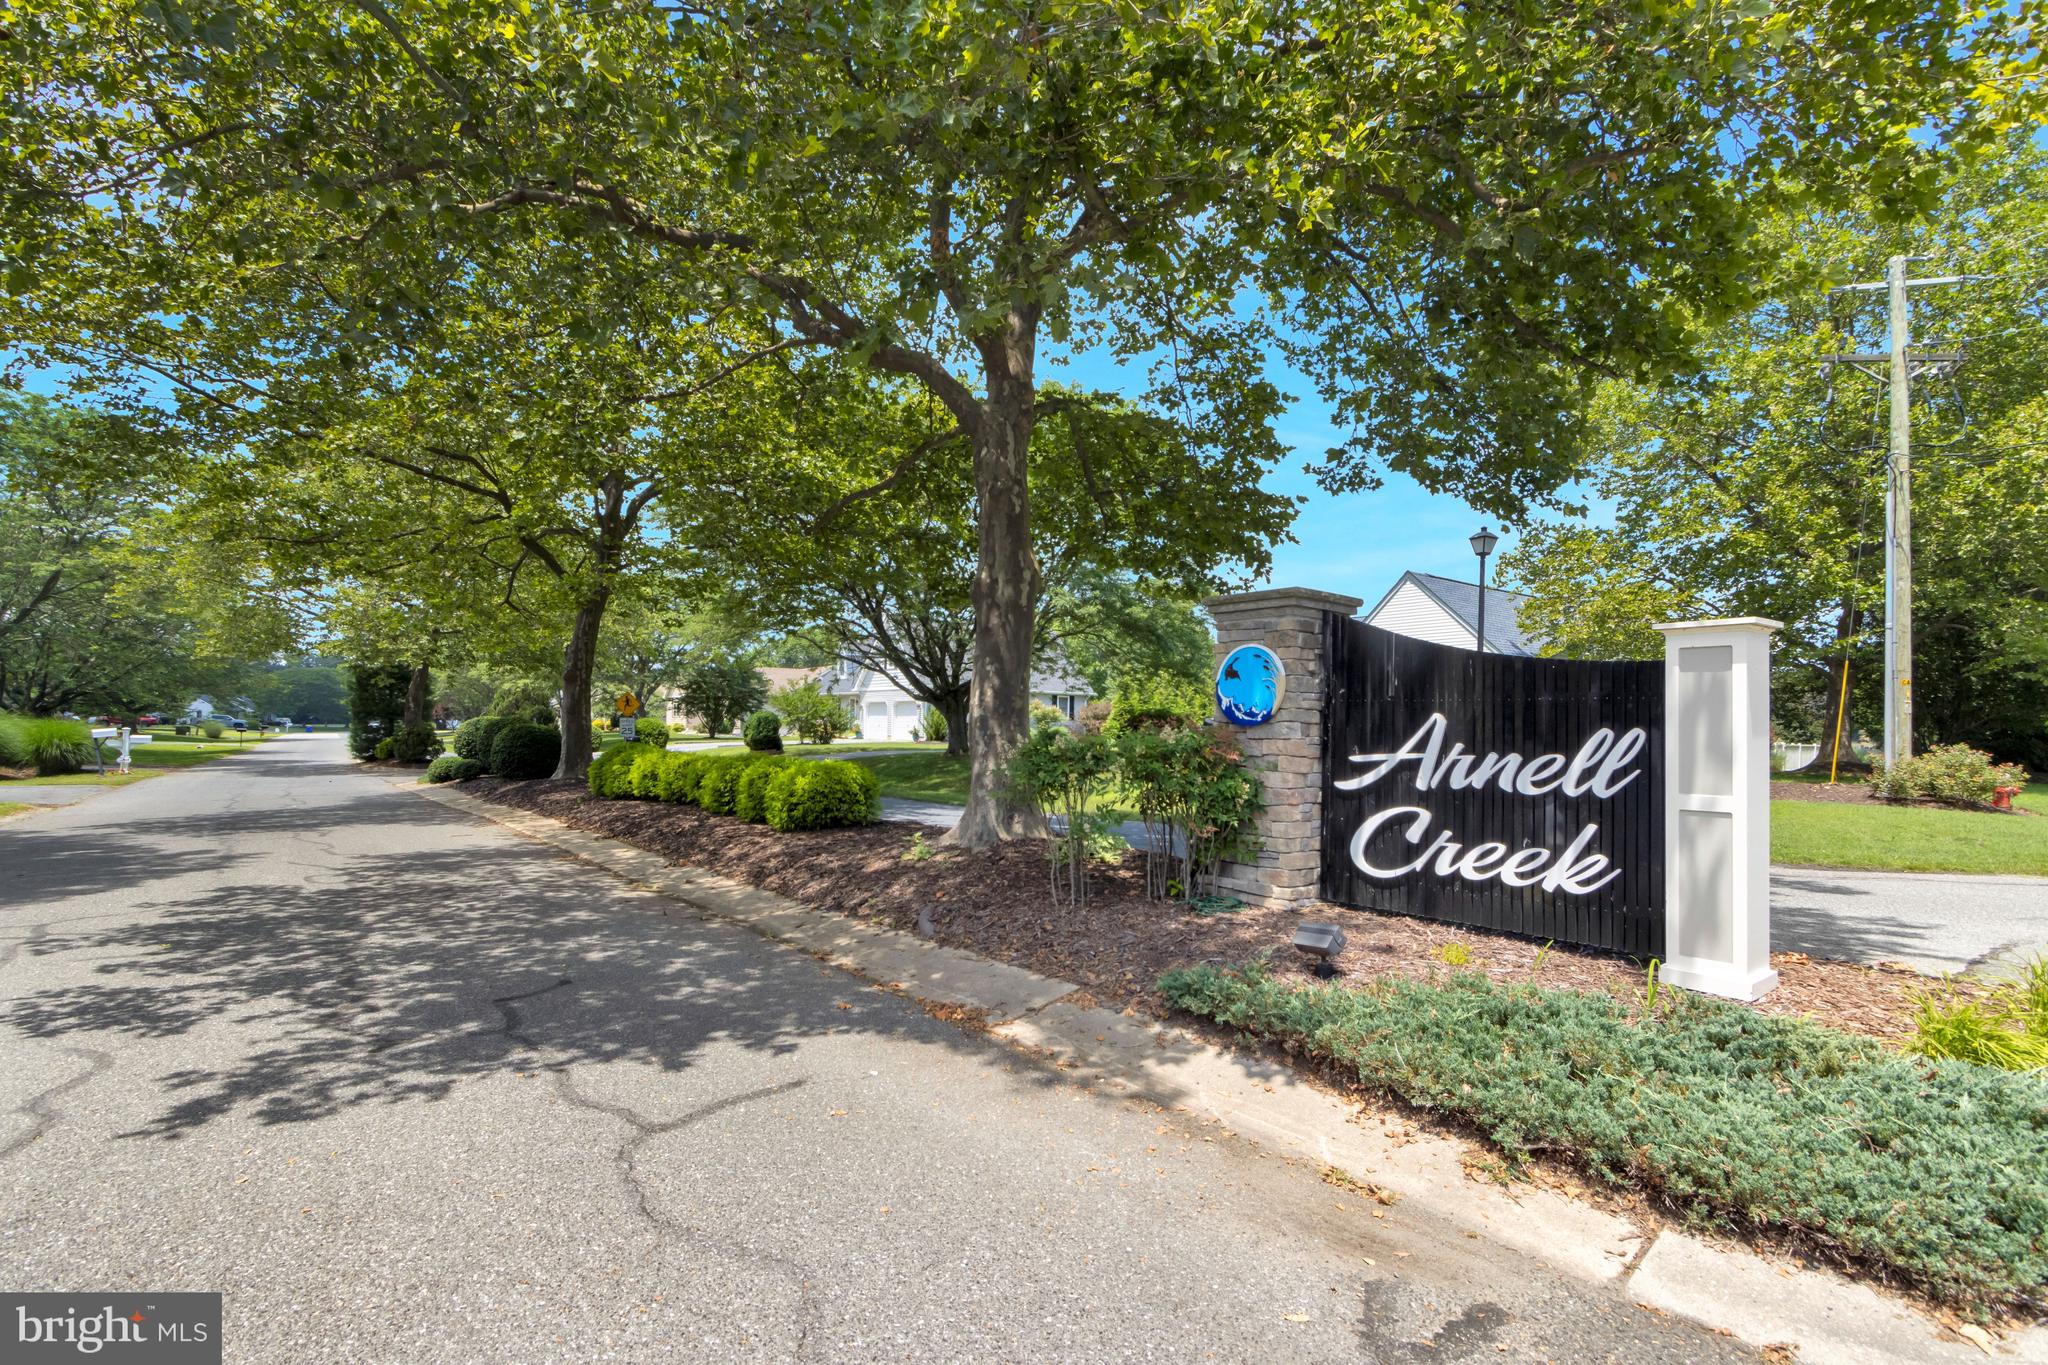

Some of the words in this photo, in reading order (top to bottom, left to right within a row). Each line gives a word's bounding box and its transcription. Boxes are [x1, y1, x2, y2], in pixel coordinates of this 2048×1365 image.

[621, 727, 633, 735] 25
[1334, 713, 1646, 798] Arnell
[1350, 807, 1622, 894] Creek
